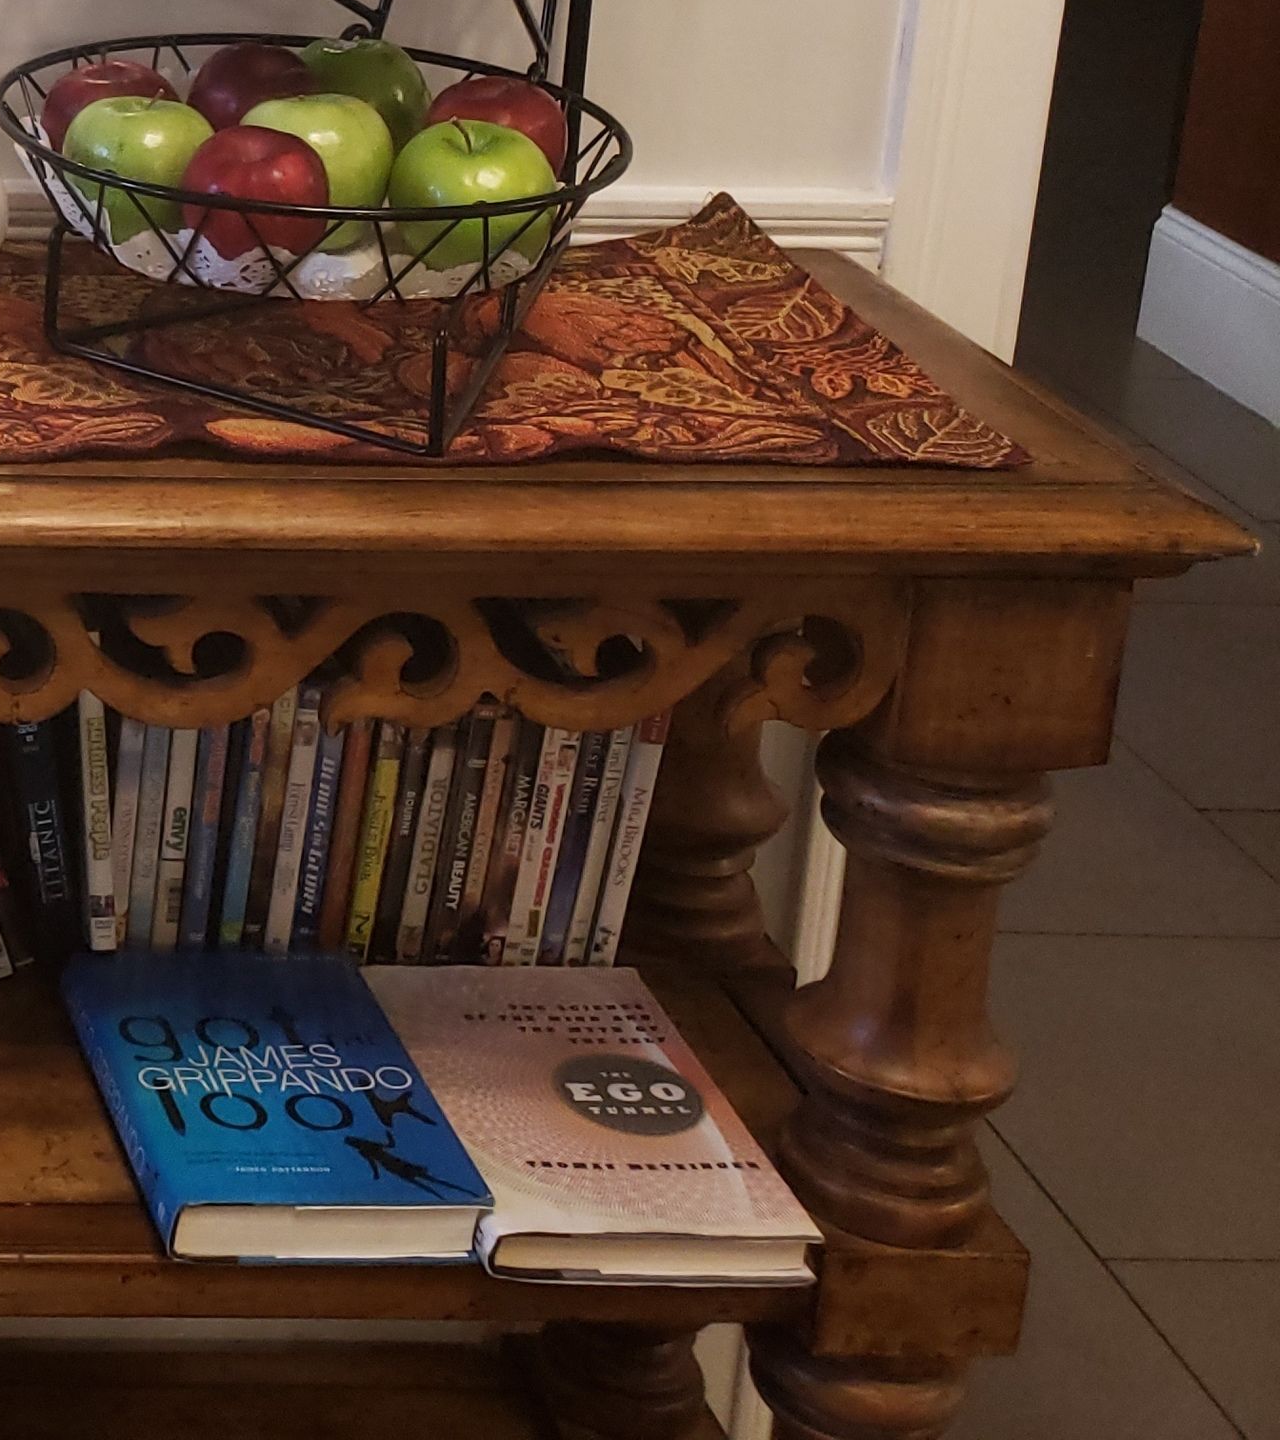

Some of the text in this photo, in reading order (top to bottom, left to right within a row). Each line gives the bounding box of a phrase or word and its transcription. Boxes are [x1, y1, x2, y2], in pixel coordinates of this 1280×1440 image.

[165, 805, 187, 852] envy
[397, 789, 417, 838] BOURNE
[453, 791, 478, 858] AMERICAN
[501, 773, 534, 858] MARGARET
[528, 783, 551, 830] GIANTS
[410, 773, 449, 896] GLADIATOR
[612, 823, 639, 888] BROOKS
[299, 848, 321, 915] GLORY
[443, 858, 466, 911] BEAUTY
[188, 1044, 343, 1070] JAMES
[138, 1066, 413, 1099] GRIPPANDO
[564, 1080, 688, 1103] EGO
[588, 1105, 693, 1116] TUNNEL
